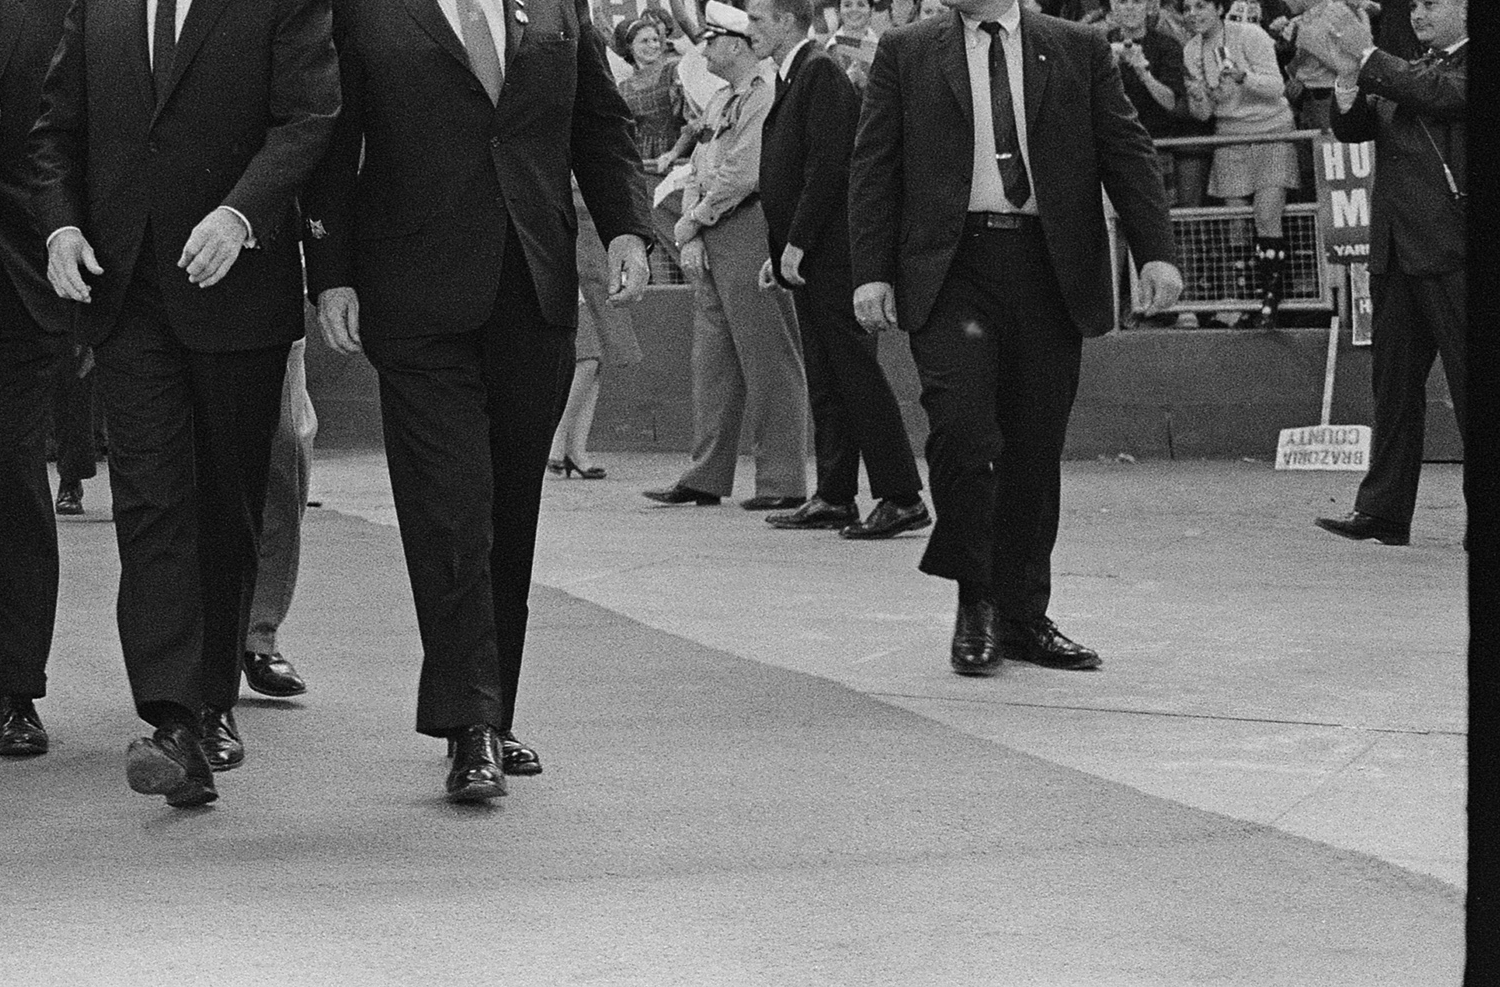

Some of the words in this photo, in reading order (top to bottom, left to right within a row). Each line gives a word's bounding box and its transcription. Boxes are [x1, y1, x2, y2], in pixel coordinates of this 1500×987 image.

[1322, 141, 1372, 181] HU
[1330, 187, 1371, 229] M
[1332, 243, 1370, 257] YAR
[1285, 426, 1360, 446] COUNTY
[1282, 449, 1365, 467] BRAZORIA
